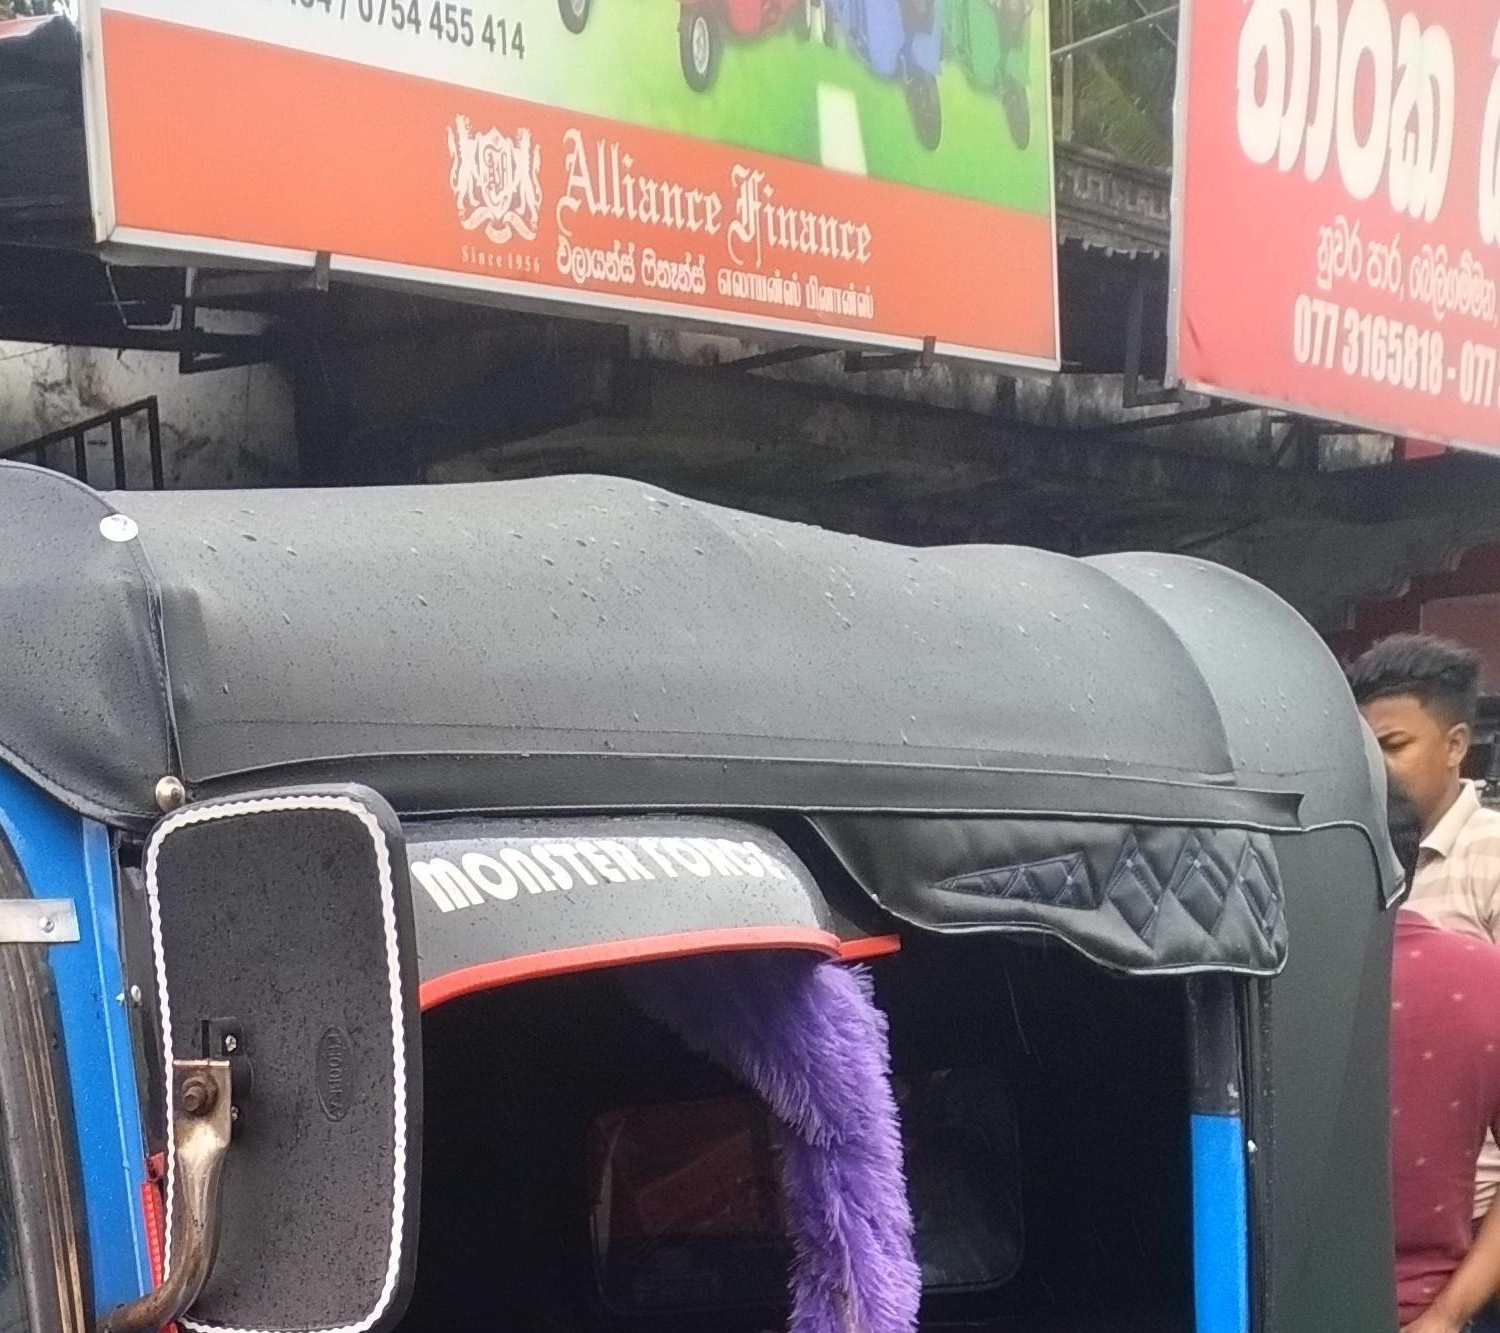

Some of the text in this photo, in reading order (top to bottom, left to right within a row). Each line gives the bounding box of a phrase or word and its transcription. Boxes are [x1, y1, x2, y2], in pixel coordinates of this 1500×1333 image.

[429, 0, 475, 48] 455
[481, 15, 526, 60] 414
[555, 128, 872, 268] Alliance Finance
[461, 244, 541, 274] Since 1956
[1294, 293, 1340, 369] 077
[1342, 307, 1445, 396] 3165818
